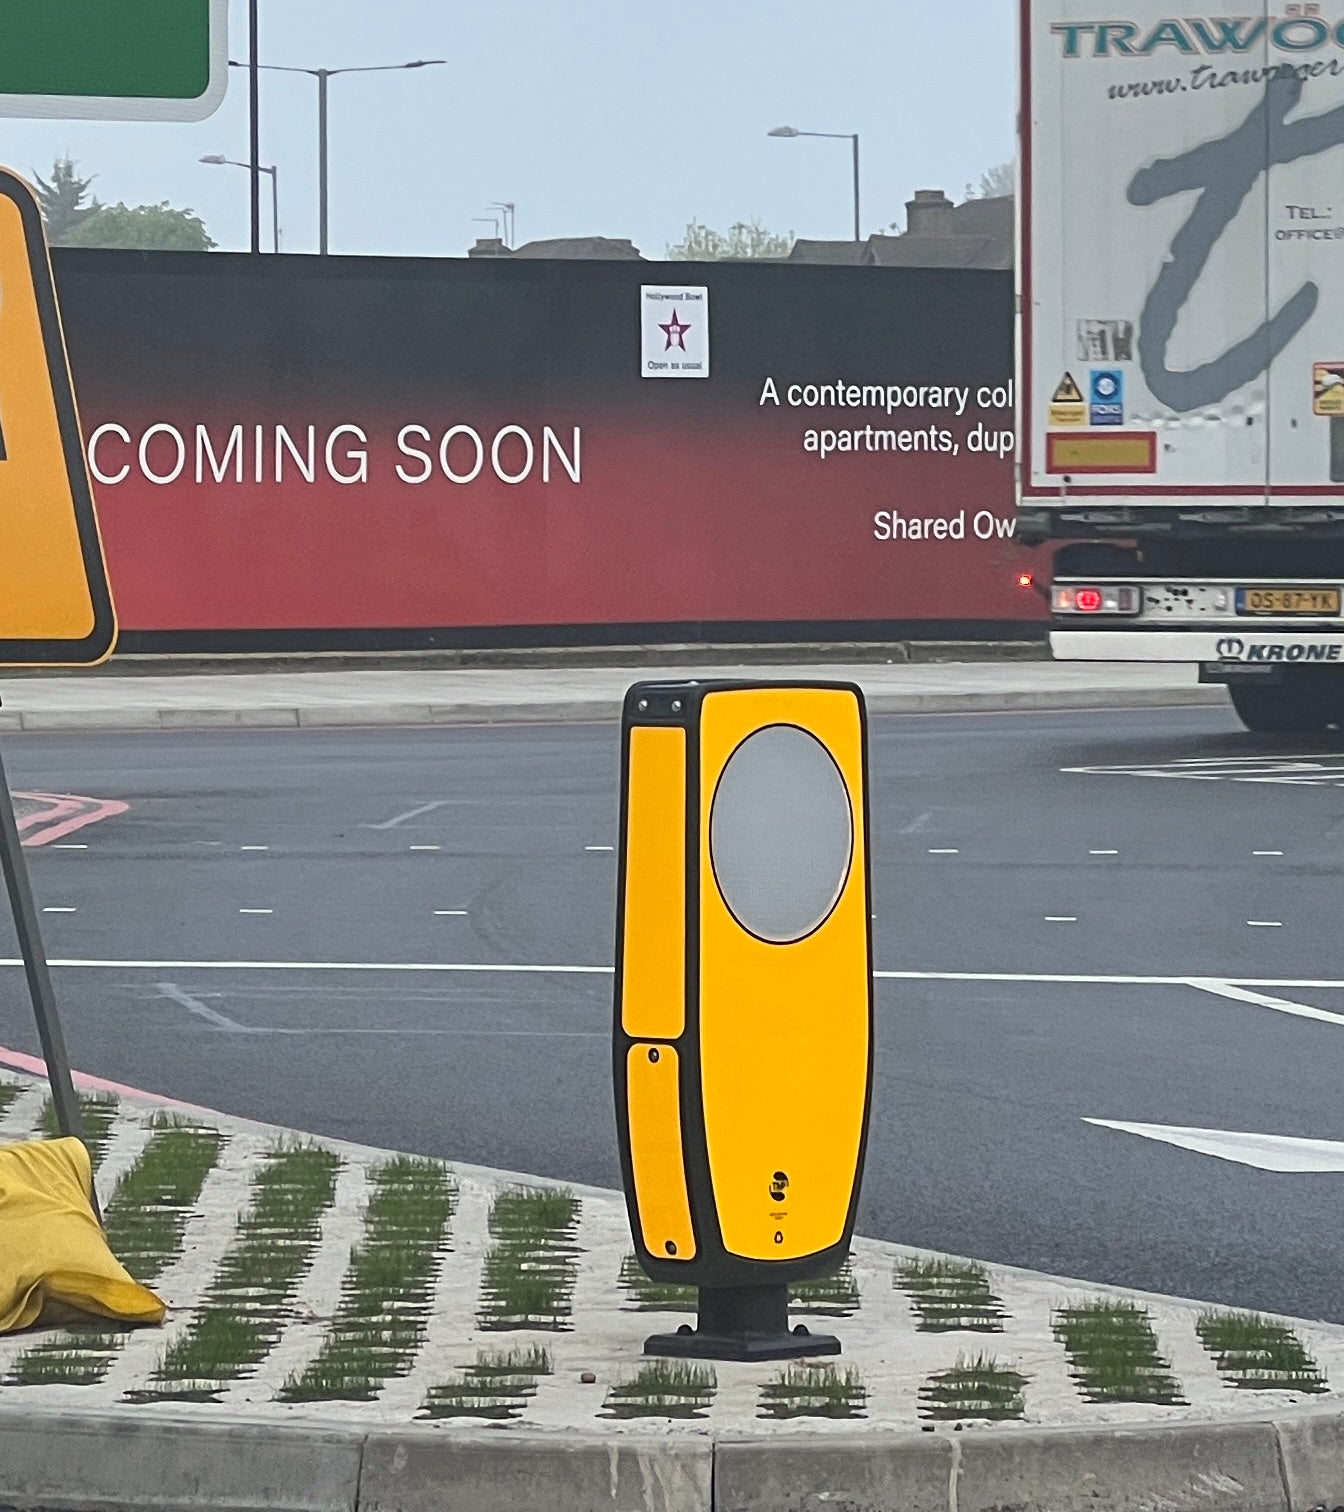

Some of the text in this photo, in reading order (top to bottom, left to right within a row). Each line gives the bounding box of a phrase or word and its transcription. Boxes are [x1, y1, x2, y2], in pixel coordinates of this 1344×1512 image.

[759, 377, 1013, 415] A contemporary col
[88, 423, 581, 484] COMING SOON
[803, 422, 1014, 459] apartments, dup
[873, 510, 1017, 539] Shared Ow
[1247, 644, 1343, 660] KRONE
